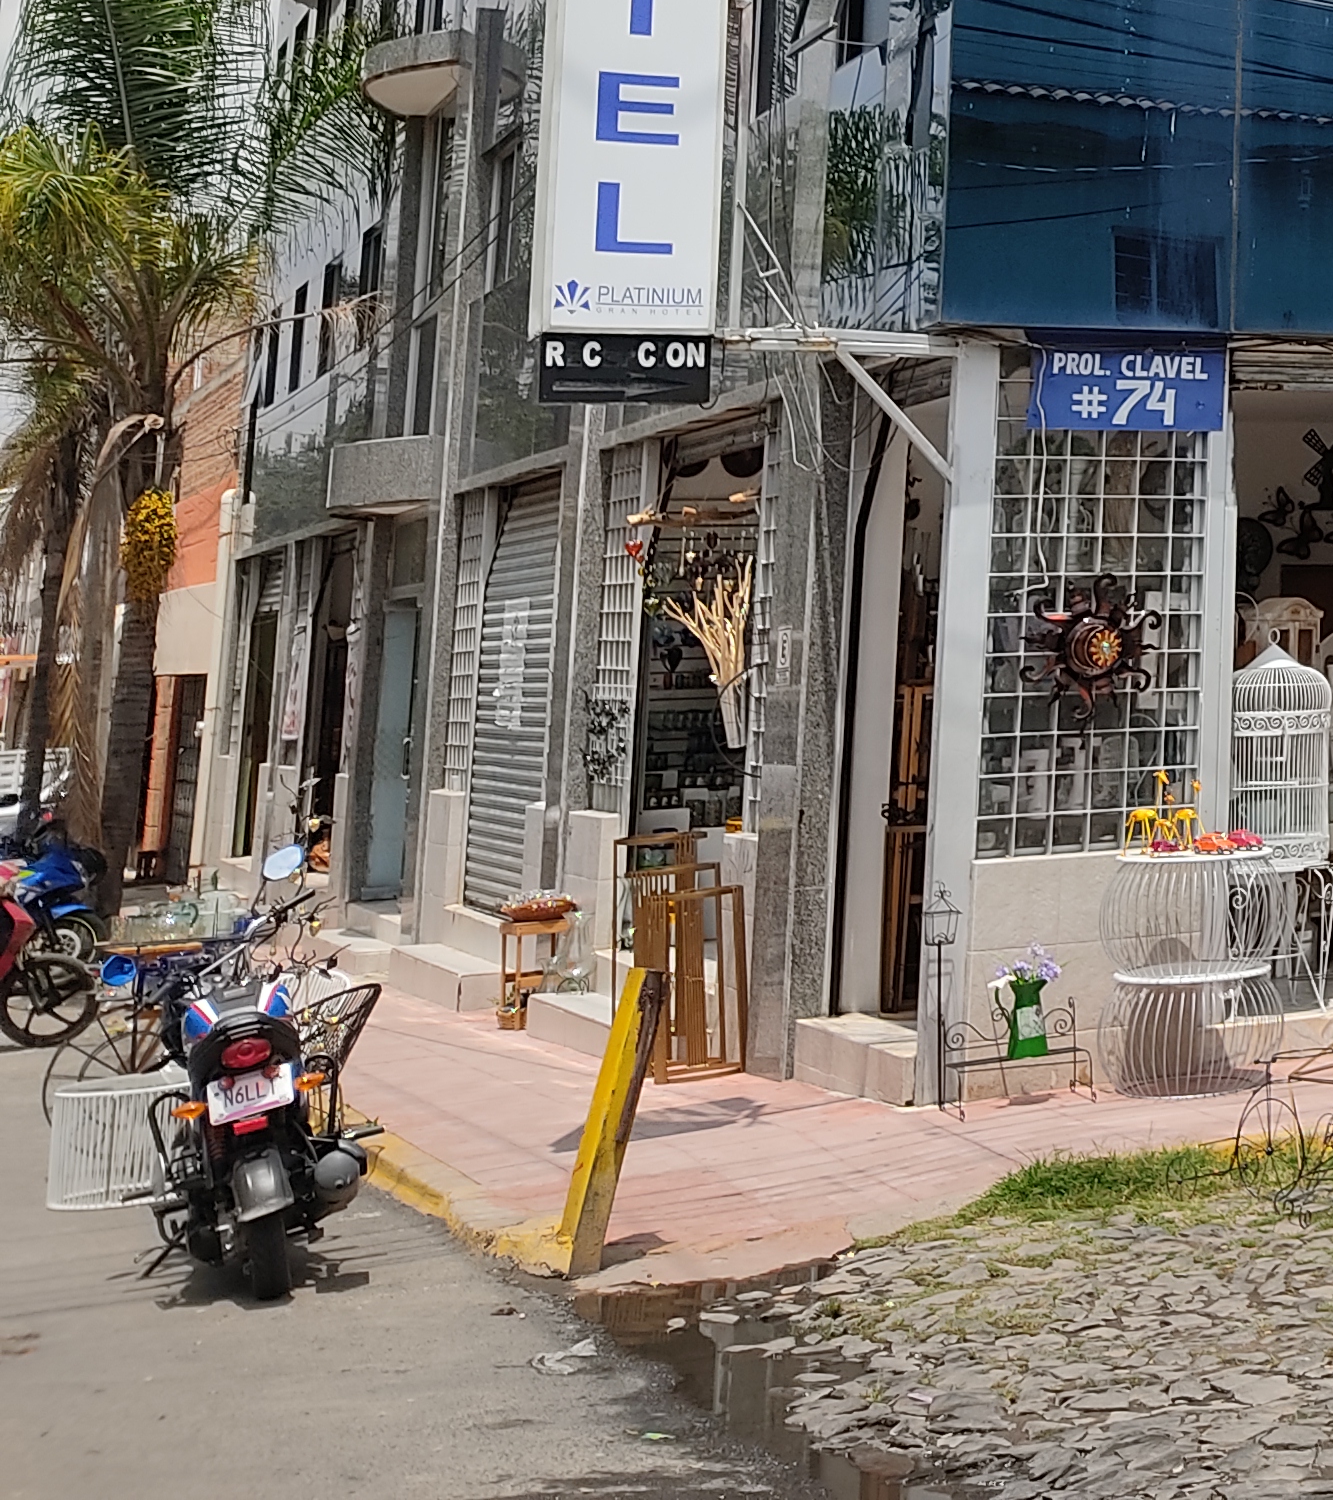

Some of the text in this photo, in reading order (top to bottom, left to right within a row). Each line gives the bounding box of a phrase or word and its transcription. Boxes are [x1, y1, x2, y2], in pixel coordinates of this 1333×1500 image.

[597, 285, 702, 305] PLATINIUM
[595, 307, 703, 316] GRAN HOTEL
[1052, 352, 1209, 380] PROL. CLAVEL
[1071, 379, 1177, 426] #74
